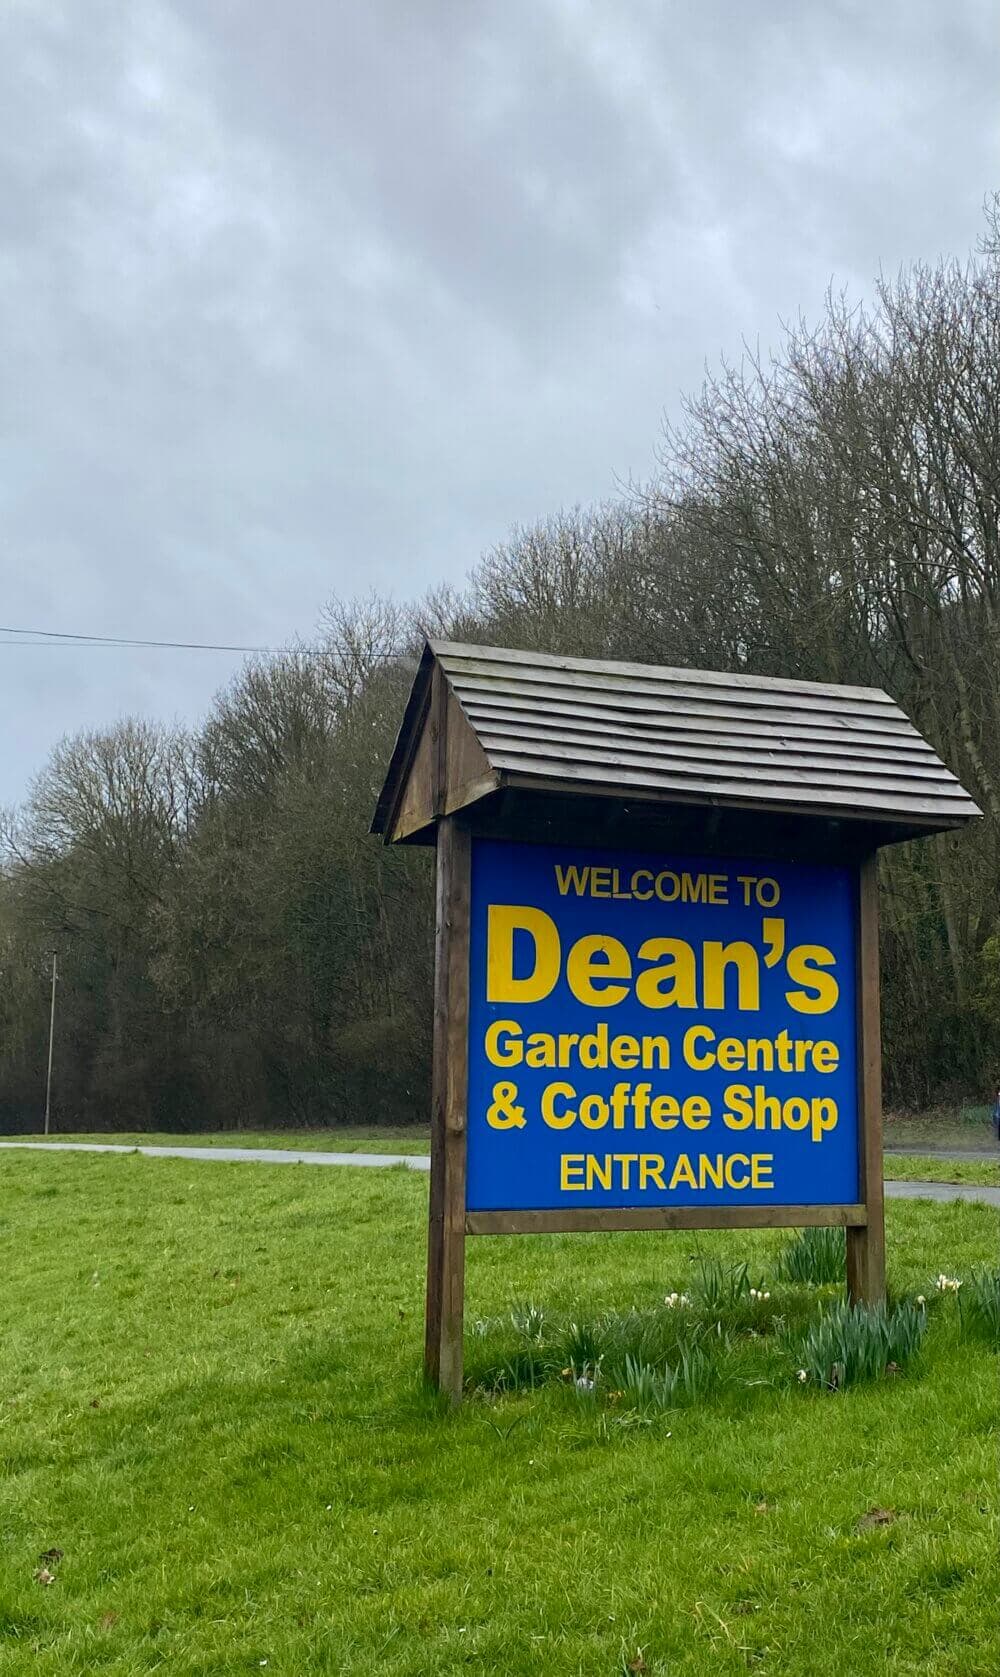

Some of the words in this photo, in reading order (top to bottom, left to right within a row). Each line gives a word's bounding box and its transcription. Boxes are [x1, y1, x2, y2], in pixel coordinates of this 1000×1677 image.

[555, 865, 727, 905] WELCOME
[737, 876, 780, 908] TO
[486, 904, 839, 1014] Dean's
[485, 1020, 670, 1070] Garden
[683, 1025, 840, 1073] Centre
[487, 1081, 526, 1130] &
[541, 1082, 711, 1130] Coffee
[723, 1084, 838, 1142] Shop
[560, 1153, 774, 1191] ENTRANCE
